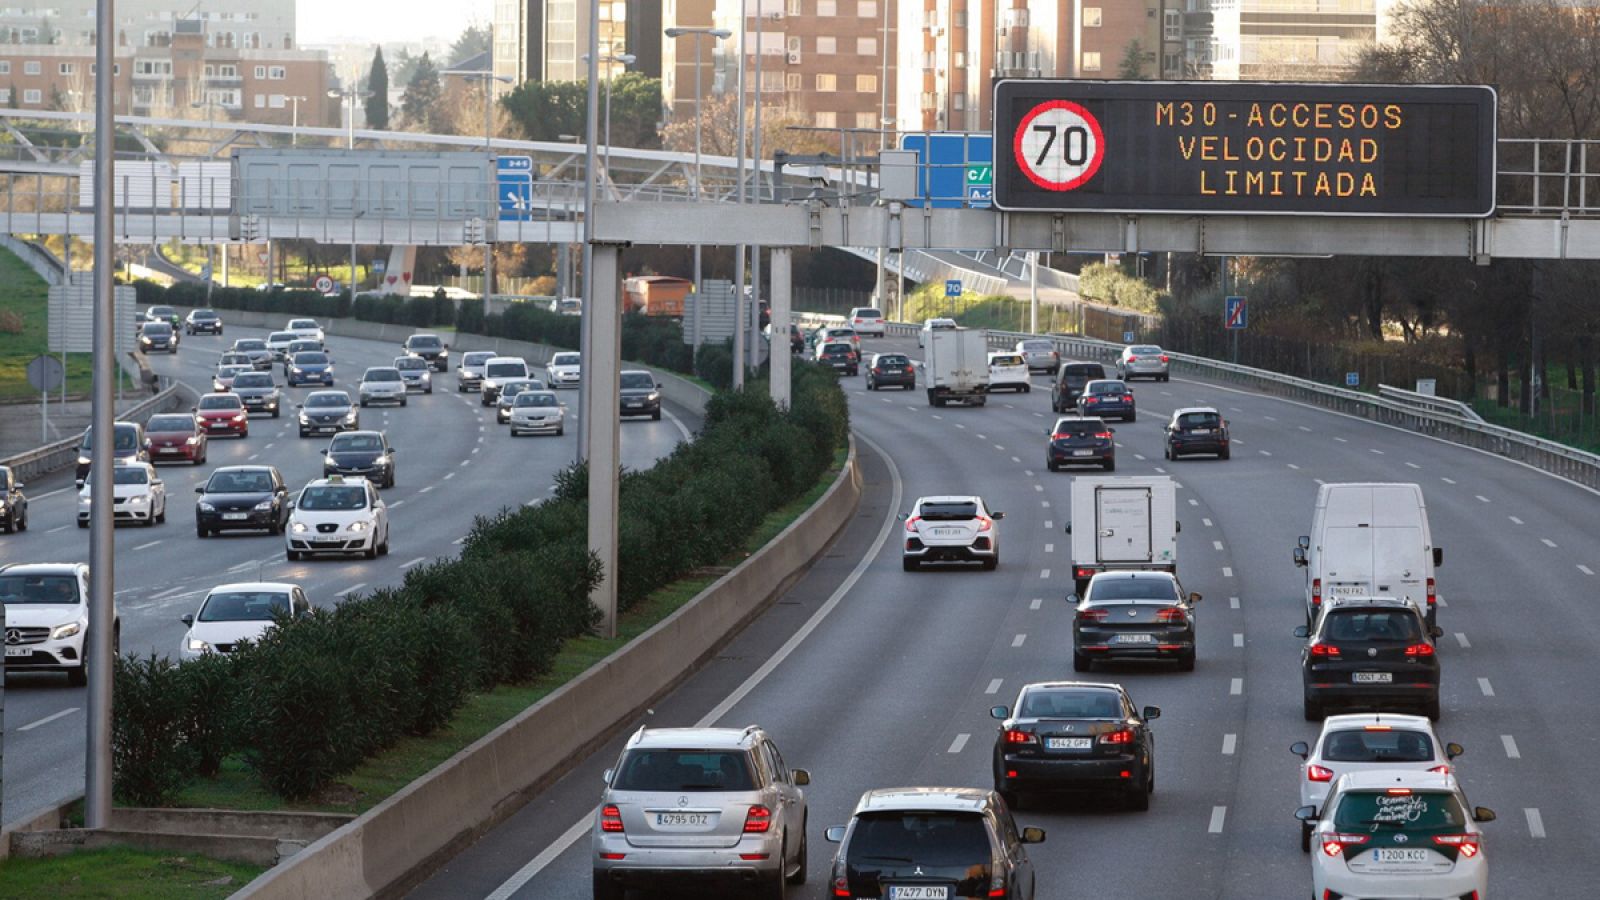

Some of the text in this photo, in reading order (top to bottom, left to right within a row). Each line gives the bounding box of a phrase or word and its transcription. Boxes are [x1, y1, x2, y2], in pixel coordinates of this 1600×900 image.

[1033, 125, 1088, 166] 70
[1178, 135, 1378, 164] VELOCIDAD
[967, 167, 992, 181] c/
[1200, 170, 1377, 197] LIMITADA
[947, 283, 961, 293] 70
[663, 815, 708, 825] 4795 GTZ
[1381, 850, 1426, 860] 1200 KCC
[896, 887, 945, 898] 7477 DYN
